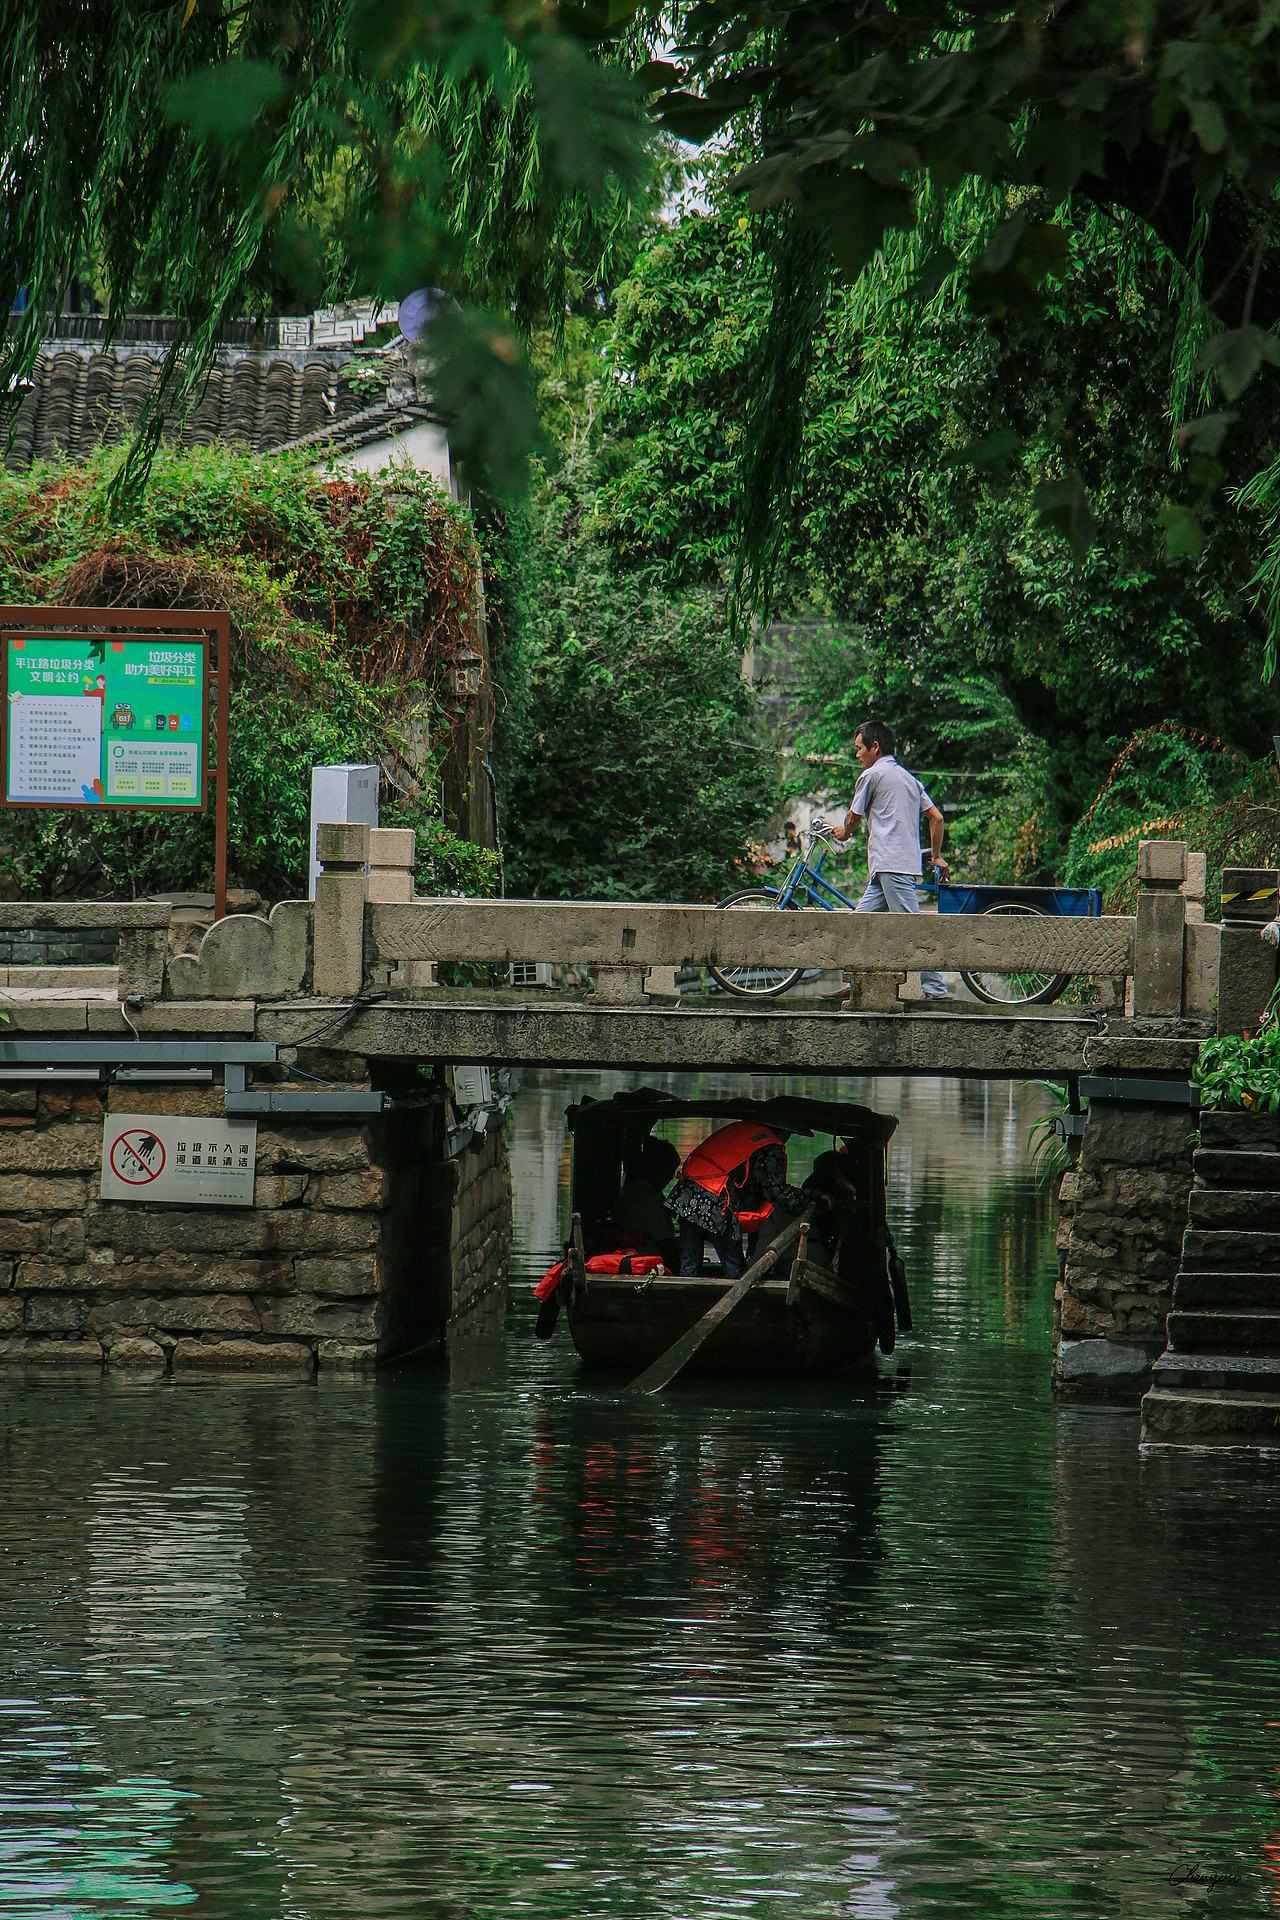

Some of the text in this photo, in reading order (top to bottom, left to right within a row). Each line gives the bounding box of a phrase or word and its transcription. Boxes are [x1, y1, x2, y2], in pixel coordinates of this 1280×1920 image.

[15, 657, 95, 671] 平江路垃圾分类
[148, 651, 196, 664] 垃圾分类
[30, 671, 80, 683] 文明公约
[125, 664, 196, 677] 助力美好平江
[176, 1142, 249, 1154] 垃圾不入河
